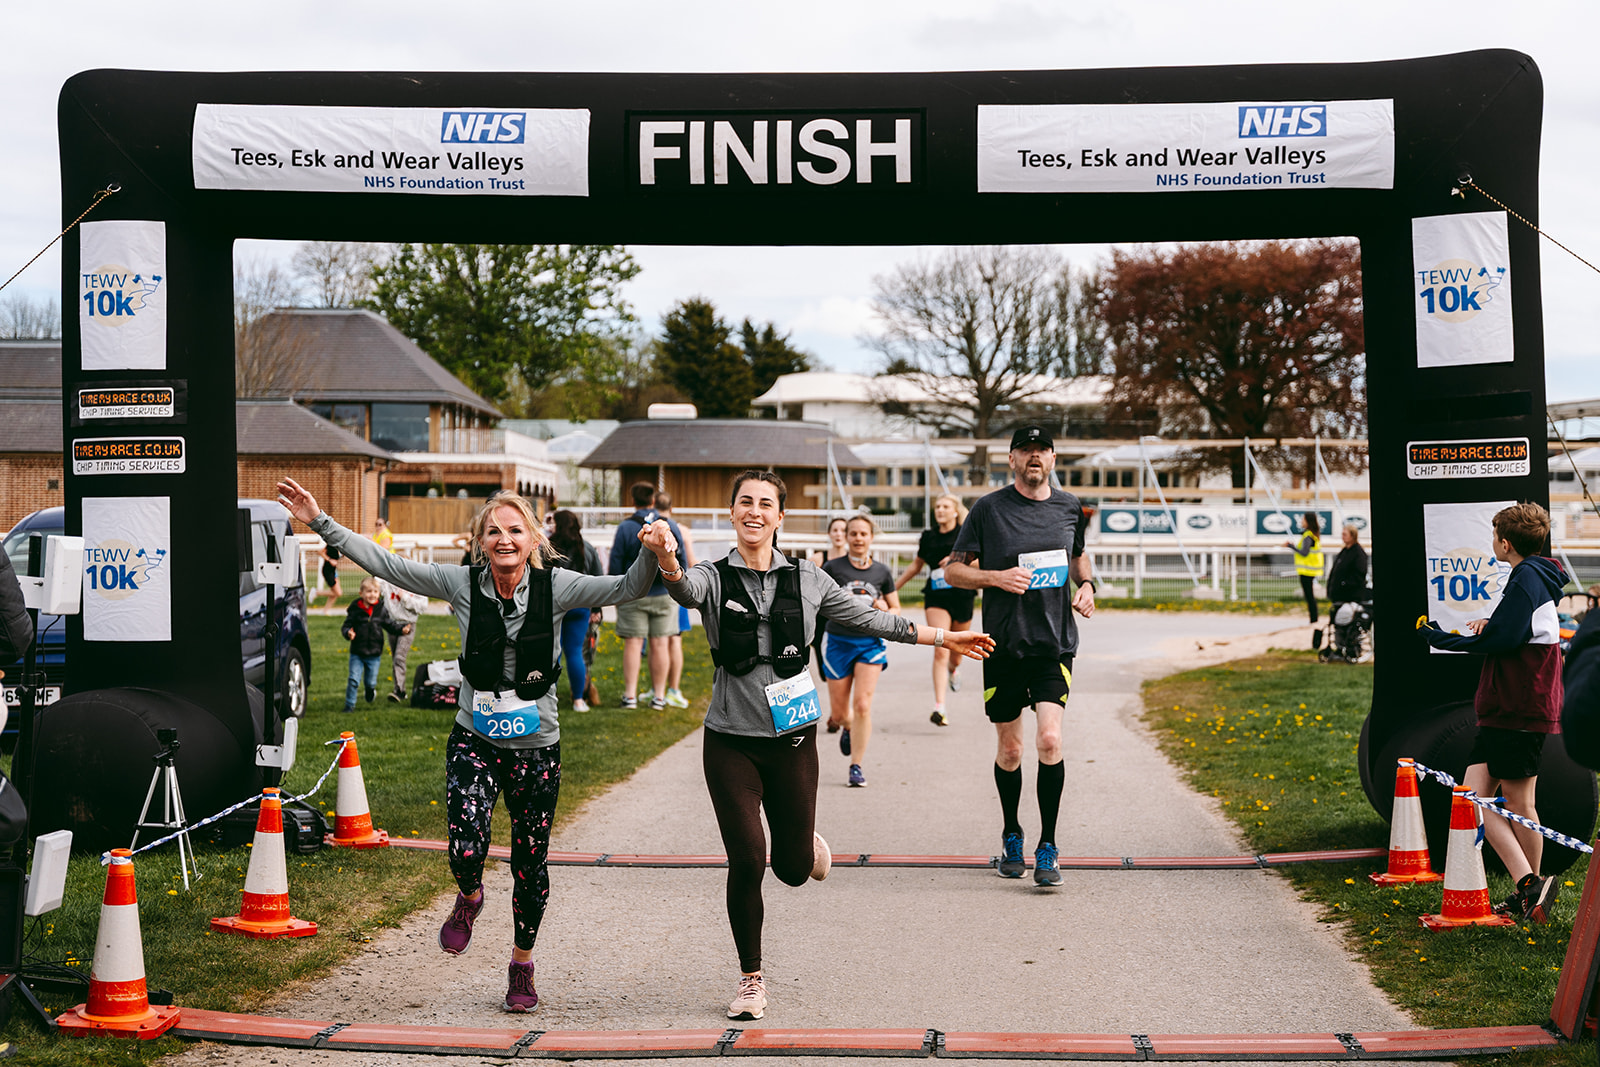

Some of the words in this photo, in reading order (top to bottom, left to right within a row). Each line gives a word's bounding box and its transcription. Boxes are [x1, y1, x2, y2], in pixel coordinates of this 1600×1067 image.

[443, 114, 523, 142] NHS
[1240, 107, 1323, 136] NHS
[639, 118, 912, 185] FINISH
[1017, 149, 1072, 170] Tees,
[1081, 148, 1118, 167] Esk
[1125, 147, 1168, 167] and
[1176, 148, 1238, 167] Wear
[1244, 145, 1326, 170] Valleys
[231, 148, 284, 169] Tees,
[291, 149, 327, 168] Esk
[333, 150, 375, 169] and
[381, 151, 440, 170] Wear
[446, 151, 524, 176] Valleys
[364, 175, 395, 189] NHS
[400, 176, 484, 190] Foundation
[488, 177, 526, 190] Trust
[1156, 173, 1189, 187] NHS
[1194, 172, 1282, 186] Foundation
[1287, 171, 1326, 184] Trust
[82, 274, 127, 288] TEWV
[1418, 268, 1473, 285] TEWV
[84, 290, 136, 317] 10k
[1419, 285, 1482, 314] 10k
[82, 408, 98, 417] CHIP
[100, 407, 126, 416] TIMING
[127, 407, 170, 415] SERVICES
[76, 462, 93, 473] CHIP
[96, 461, 126, 471] TIMING
[129, 460, 180, 471] SERVICES
[1414, 465, 1438, 476] CHIP
[1442, 464, 1477, 475] TIMING
[1480, 462, 1526, 475] SERVICES
[85, 548, 131, 563] TEWV
[1429, 557, 1482, 573] TEWV
[86, 565, 139, 590] 10k
[1031, 571, 1059, 588] 224
[1430, 574, 1492, 602] 10k
[772, 692, 790, 705] 10k
[476, 702, 494, 713] 10k
[786, 698, 818, 726] 244
[487, 716, 526, 737] 296
